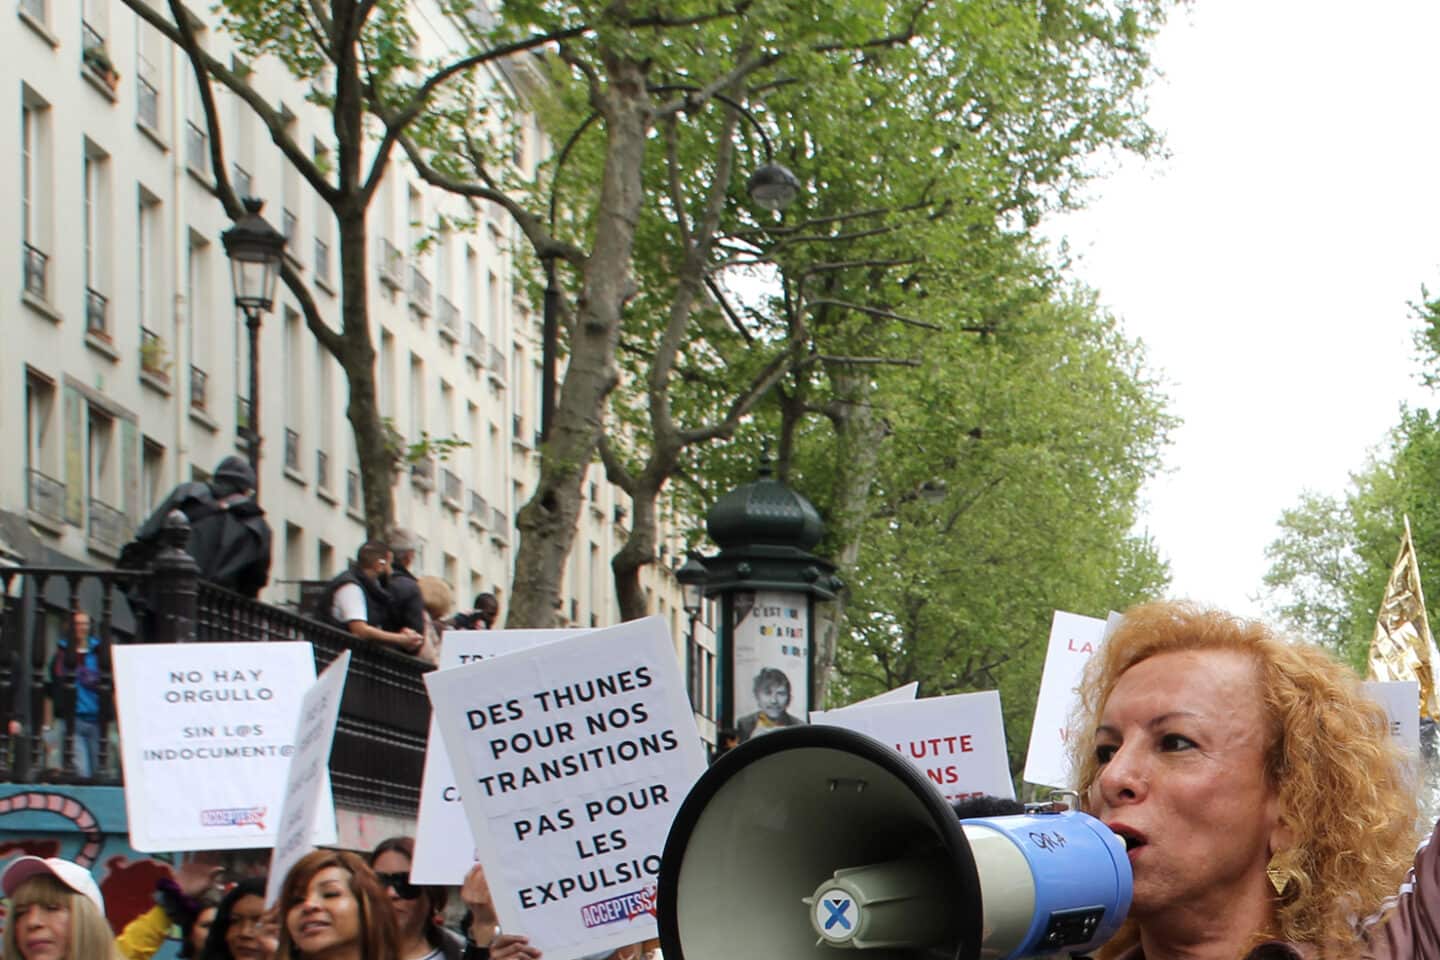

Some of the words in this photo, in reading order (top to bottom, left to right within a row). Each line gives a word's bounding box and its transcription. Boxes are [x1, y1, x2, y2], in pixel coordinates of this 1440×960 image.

[169, 670, 202, 684] NO
[214, 669, 264, 682] HAY
[165, 688, 274, 703] ORGULLO
[466, 699, 524, 731] DES
[534, 666, 653, 713] THUNES
[183, 726, 214, 738] SIN
[490, 722, 575, 760] POUR
[587, 702, 649, 735] NOS
[895, 734, 974, 760] UTTE
[478, 730, 679, 797] TRANSITIONS
[514, 808, 575, 841] PAS
[586, 784, 670, 822] POUR
[576, 829, 628, 860] LES
